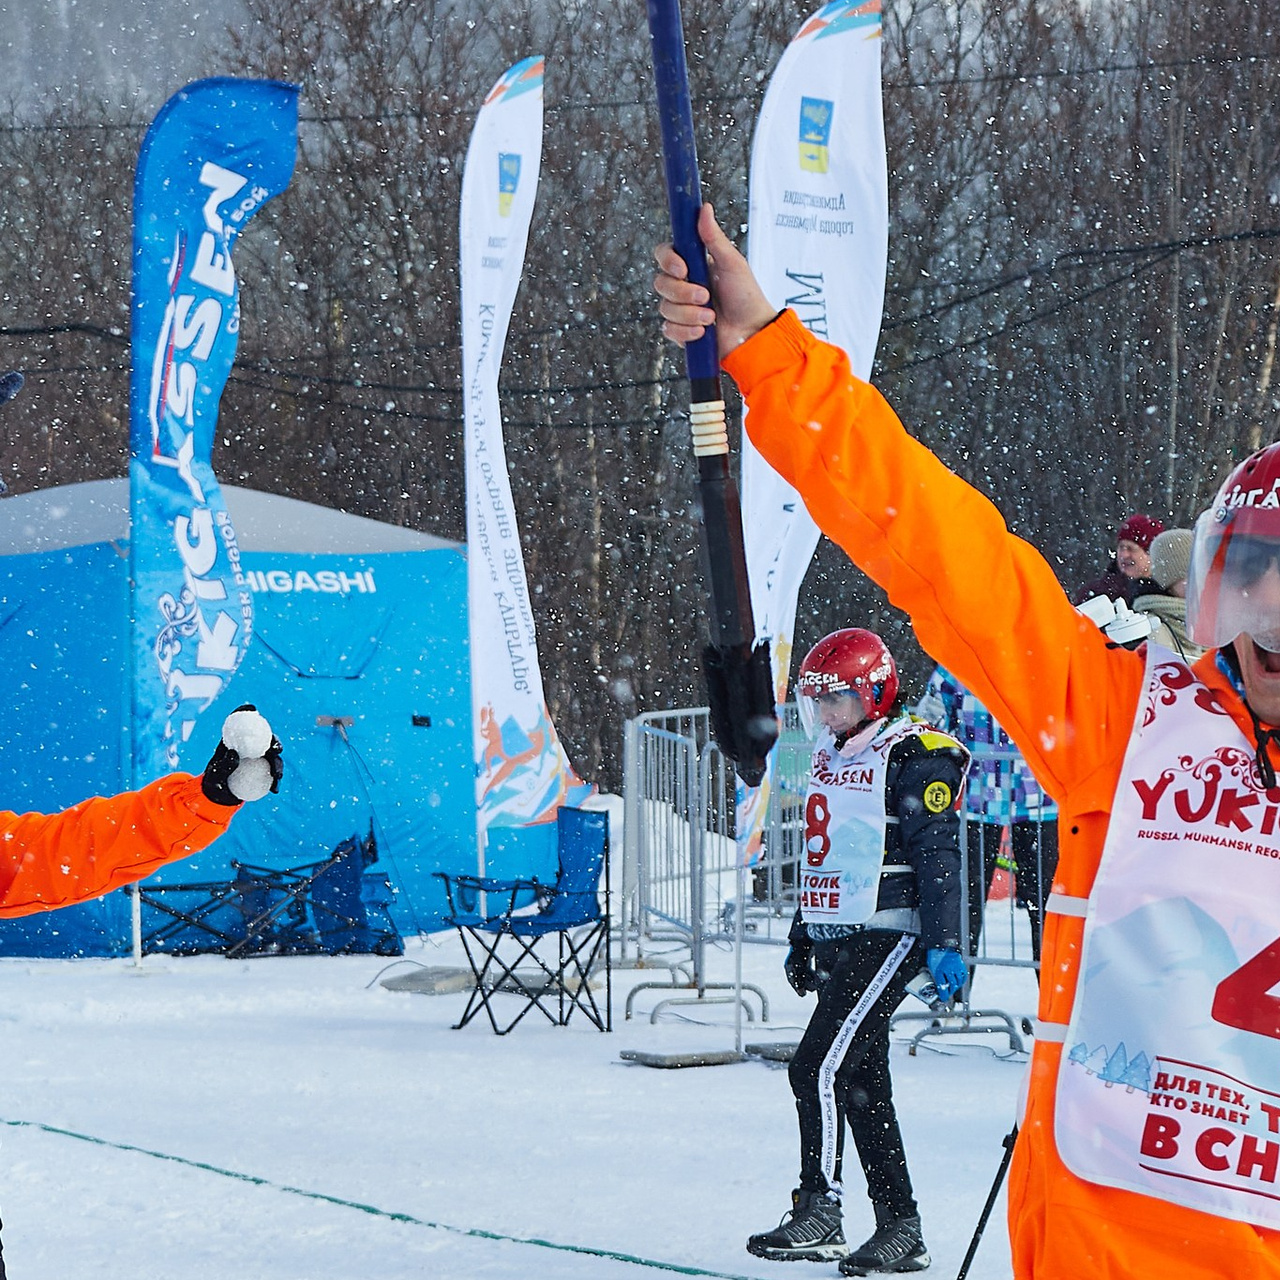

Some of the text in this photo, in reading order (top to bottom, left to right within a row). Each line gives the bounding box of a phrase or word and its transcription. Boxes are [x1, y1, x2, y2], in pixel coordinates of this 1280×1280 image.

[245, 570, 376, 594] HIGASHI
[805, 792, 832, 867] 8
[1184, 832, 1253, 853] MURMANSK
[802, 892, 840, 909] НЕГЕ
[1154, 1072, 1251, 1111] ДЛЯ ТЕХ,
[1150, 1092, 1250, 1126] КТО ЗНАЕТ
[1140, 1112, 1181, 1159] В
